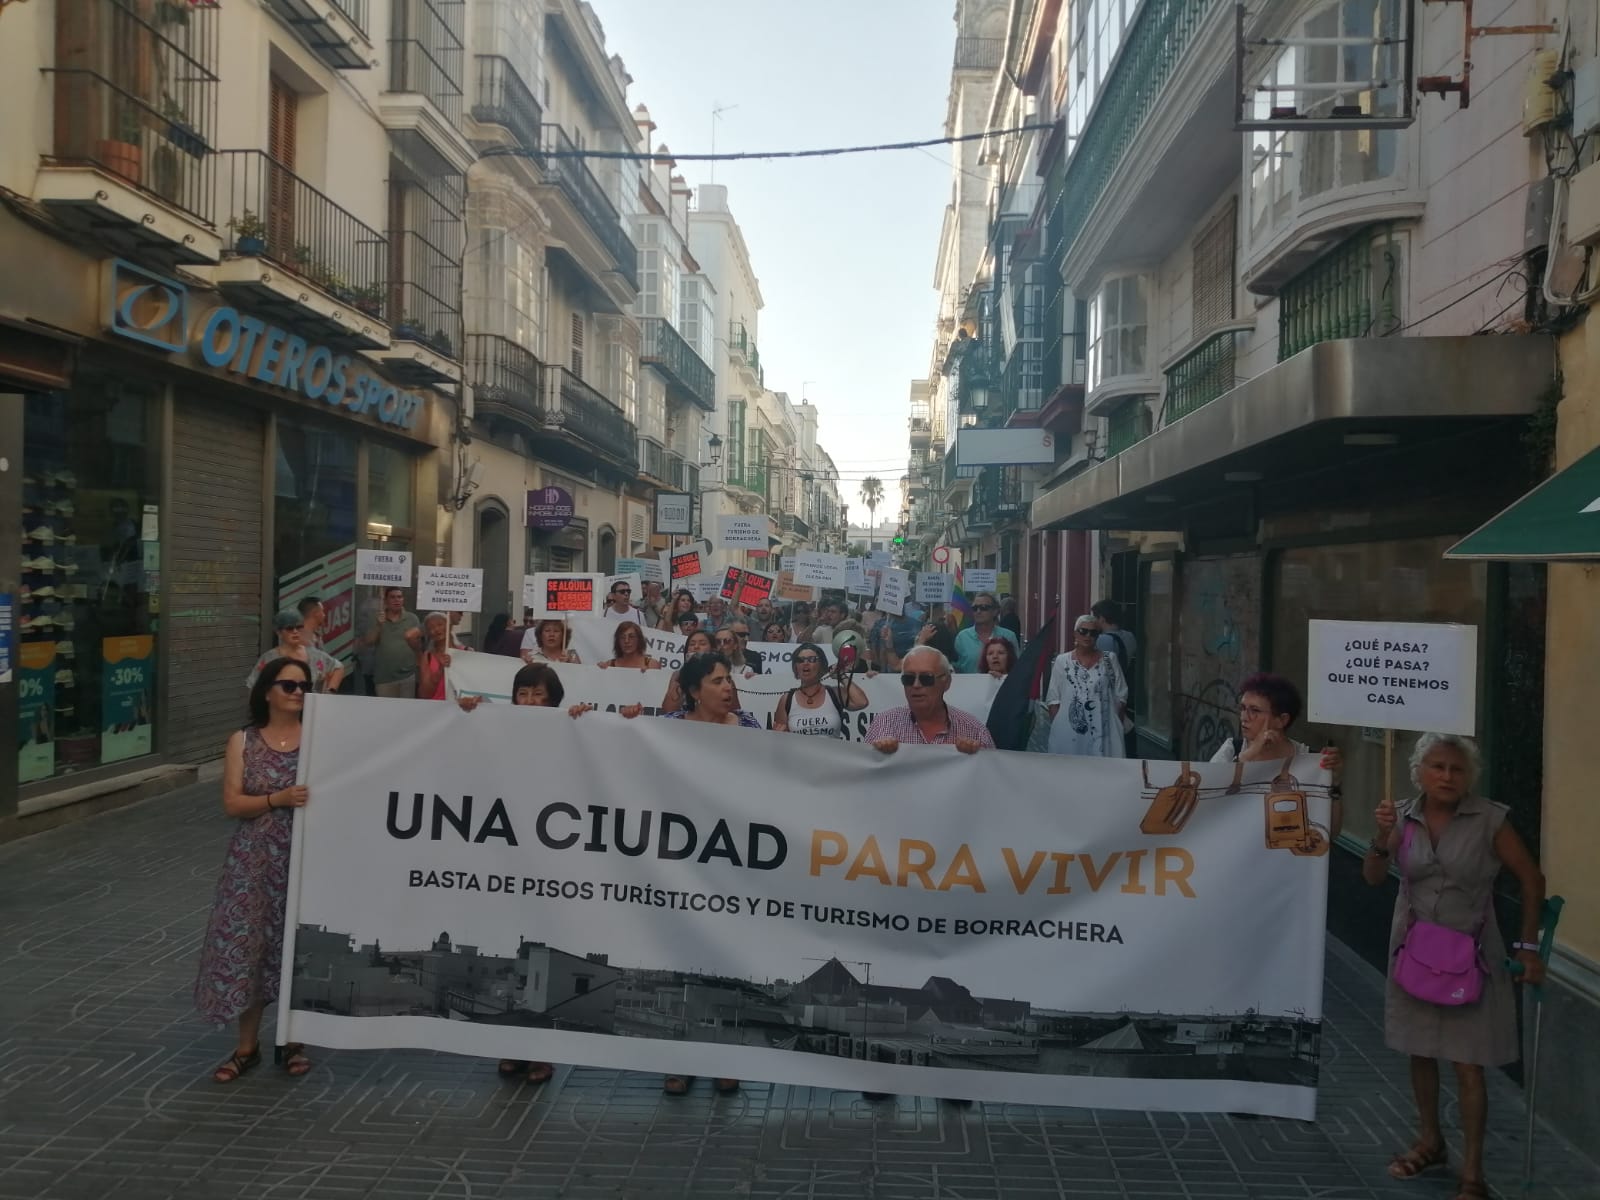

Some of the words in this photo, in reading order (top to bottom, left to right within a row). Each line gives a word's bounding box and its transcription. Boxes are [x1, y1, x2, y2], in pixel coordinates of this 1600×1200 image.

[202, 306, 351, 406] OTEROS
[347, 371, 425, 430] SPORT
[374, 555, 393, 563] FUERA
[363, 573, 402, 582] BORRACHERA
[548, 580, 558, 591] SE
[558, 580, 592, 591] ALQUILA
[1344, 638, 1380, 652] ¿QUÉ
[1383, 641, 1429, 653] PASA?
[1345, 656, 1381, 669] ¿QUÉ
[1384, 659, 1430, 671] PASA?
[110, 666, 144, 686] -30%
[1328, 672, 1354, 684] QUE
[1358, 675, 1379, 686] NO
[1382, 676, 1449, 690] TENEMOS
[1367, 693, 1406, 706] CASA
[796, 717, 829, 727] FUERA
[793, 727, 834, 736] RISMO
[386, 790, 519, 847] UNA
[535, 801, 789, 871] CIUDAD
[808, 828, 987, 894] PARA
[1000, 845, 1198, 899] VIVIR
[408, 870, 482, 892] BASTA
[486, 873, 516, 894] DE
[521, 876, 595, 901] PISOS
[599, 882, 741, 915] TURÍSTICOS
[745, 896, 761, 915] Y
[766, 898, 796, 919] DE
[800, 902, 910, 932] TURISMO
[917, 916, 947, 934] DE
[953, 918, 1125, 945] BORRACHERA
